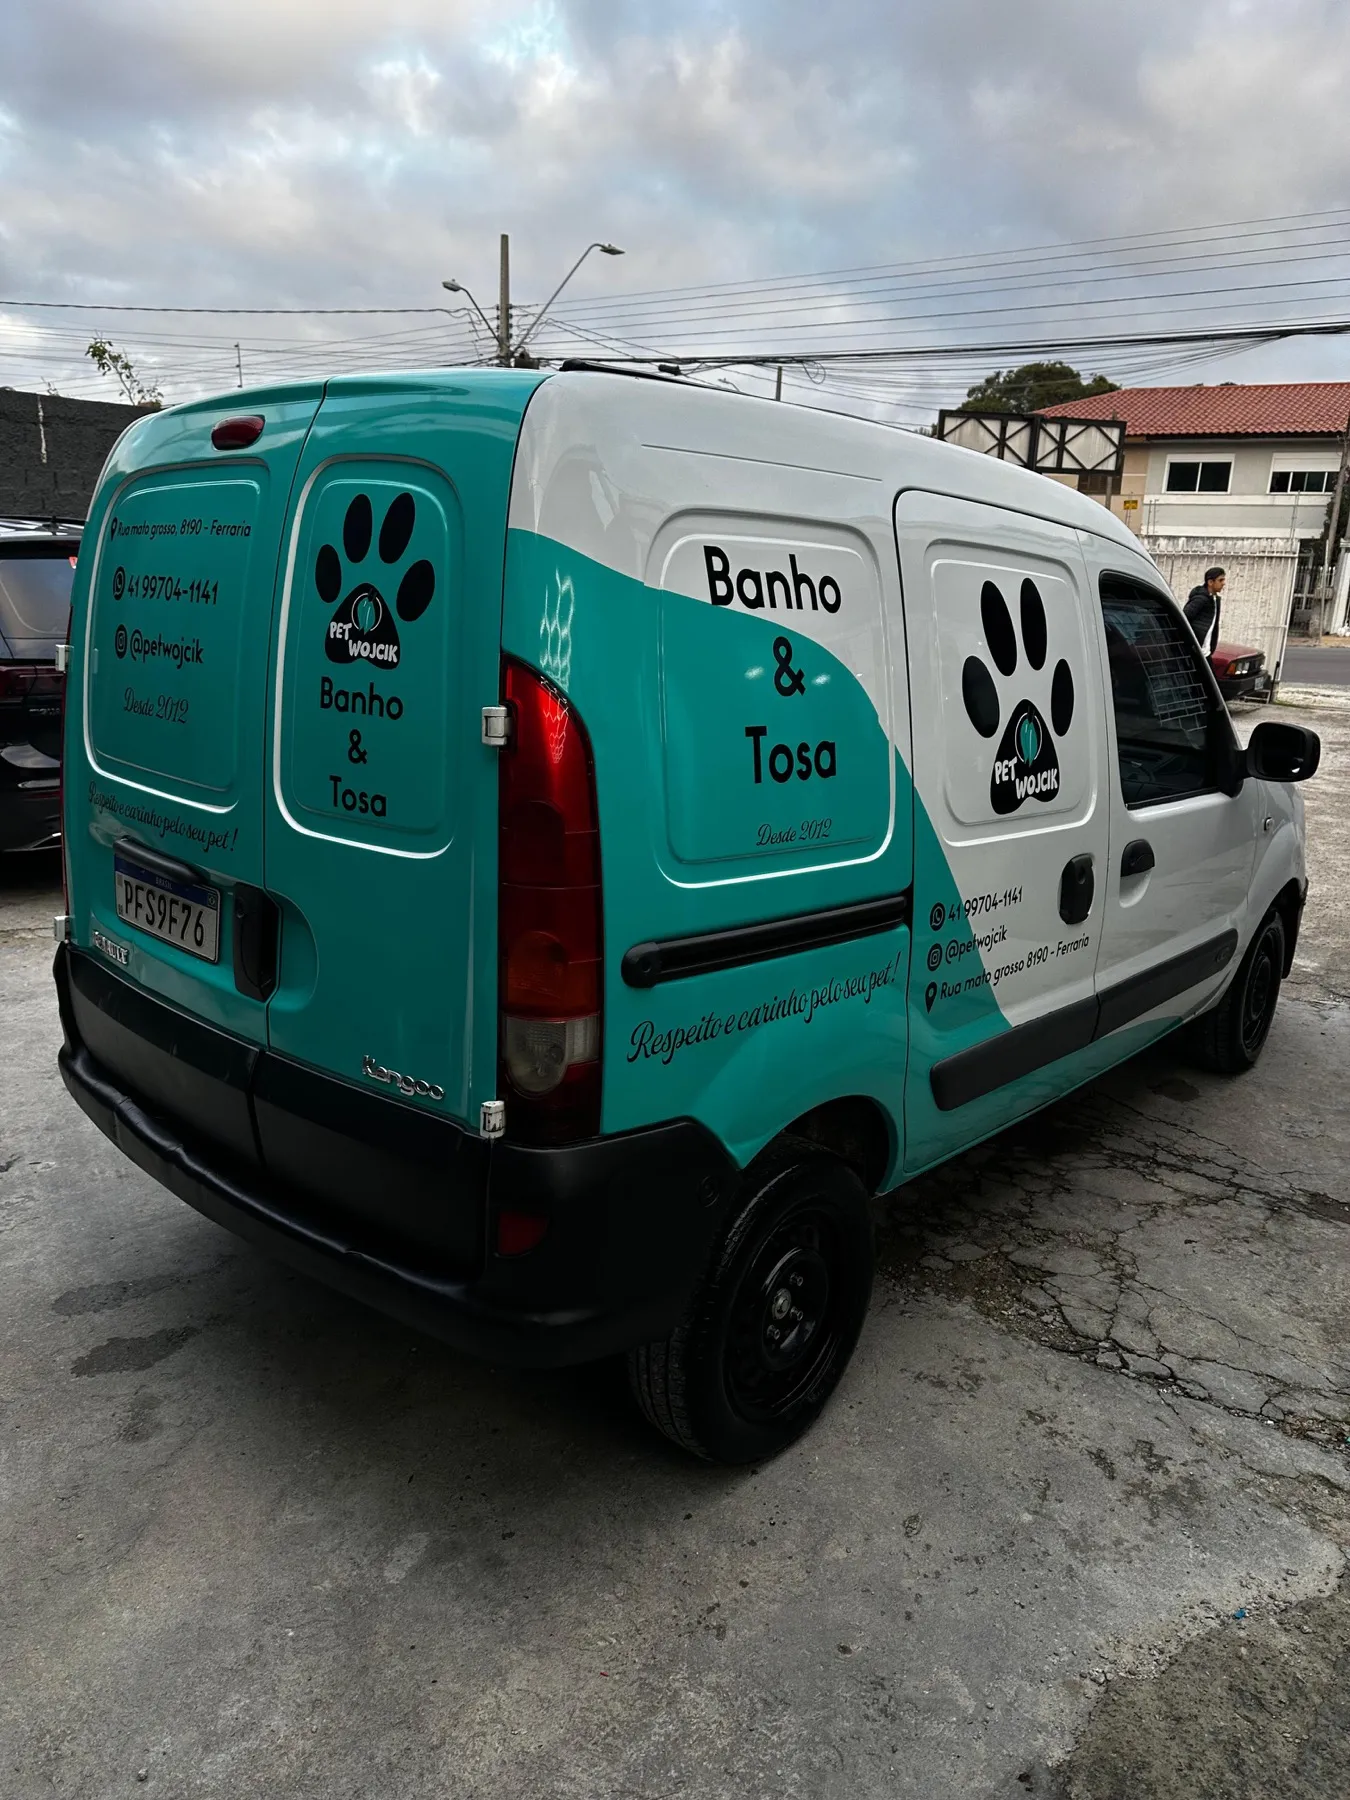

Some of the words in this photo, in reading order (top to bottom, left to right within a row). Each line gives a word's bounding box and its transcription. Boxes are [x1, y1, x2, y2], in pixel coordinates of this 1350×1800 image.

[131, 520, 149, 536] mato
[150, 526, 178, 540] grosso,
[180, 519, 203, 535] 8190
[210, 519, 251, 538] Ferraria
[128, 575, 140, 597] 41
[141, 574, 219, 605] 99704-1141
[703, 545, 842, 613] Banho
[130, 629, 204, 669] @petwojcik
[330, 621, 352, 639] PET
[349, 640, 398, 663] WOJCIK
[773, 636, 806, 697] &
[124, 687, 154, 716] Desde
[156, 694, 189, 724] 2012
[320, 676, 404, 720] Banho
[348, 729, 368, 764] &
[745, 725, 837, 784] Tosa
[994, 756, 1017, 784] PET
[1015, 768, 1058, 799] WOJCIK
[89, 781, 118, 813] Respeito
[124, 803, 161, 828] carinho
[160, 814, 185, 838] pelo
[186, 823, 205, 843] seu
[329, 774, 387, 817] Tosa
[756, 824, 797, 846] Desde
[799, 818, 832, 841] 2012
[124, 879, 204, 948] PFS9F76
[948, 903, 961, 922] 41
[964, 885, 1023, 917] 99704-1141
[945, 924, 1008, 965] @petwojcik
[940, 982, 962, 1000] Rua
[964, 970, 991, 990] mato
[993, 959, 1025, 987] grosso
[1026, 945, 1049, 969] 8190
[1056, 933, 1089, 957] Ferraria
[627, 1019, 724, 1065] Respeito
[724, 1014, 735, 1035] e
[737, 987, 808, 1030] carinho
[803, 976, 843, 1023] pelo
[842, 977, 868, 1000] seu
